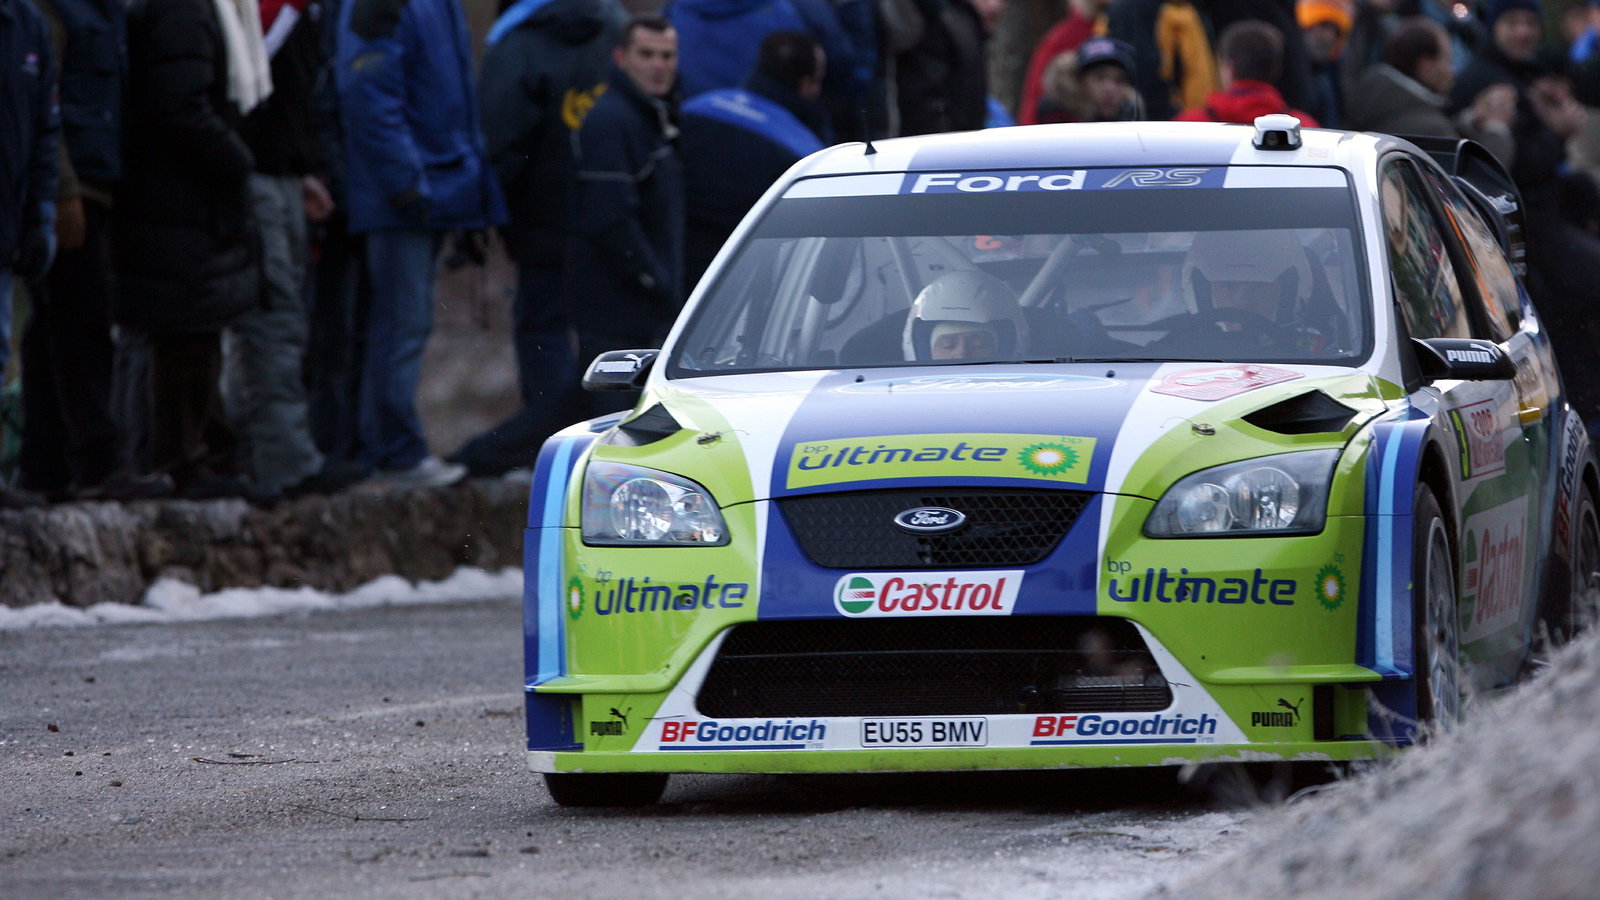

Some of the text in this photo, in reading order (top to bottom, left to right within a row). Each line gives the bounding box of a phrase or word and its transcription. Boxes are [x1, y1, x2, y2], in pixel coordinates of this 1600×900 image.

[911, 168, 1210, 193] Ford RS
[1446, 350, 1492, 363] PUMA
[803, 445, 829, 454] bp
[1061, 436, 1083, 445] bp
[798, 442, 1008, 471] ultimate
[910, 510, 949, 525] Ford
[1107, 556, 1132, 575] bp
[595, 574, 750, 616] ultimate
[878, 577, 1007, 612] Castrol
[1108, 568, 1297, 606] ultimate
[1032, 713, 1217, 737] BFGoodrich
[1252, 712, 1293, 727] PUMA
[661, 720, 826, 742] BFGoodrich
[864, 721, 983, 743] EU55 BMV
